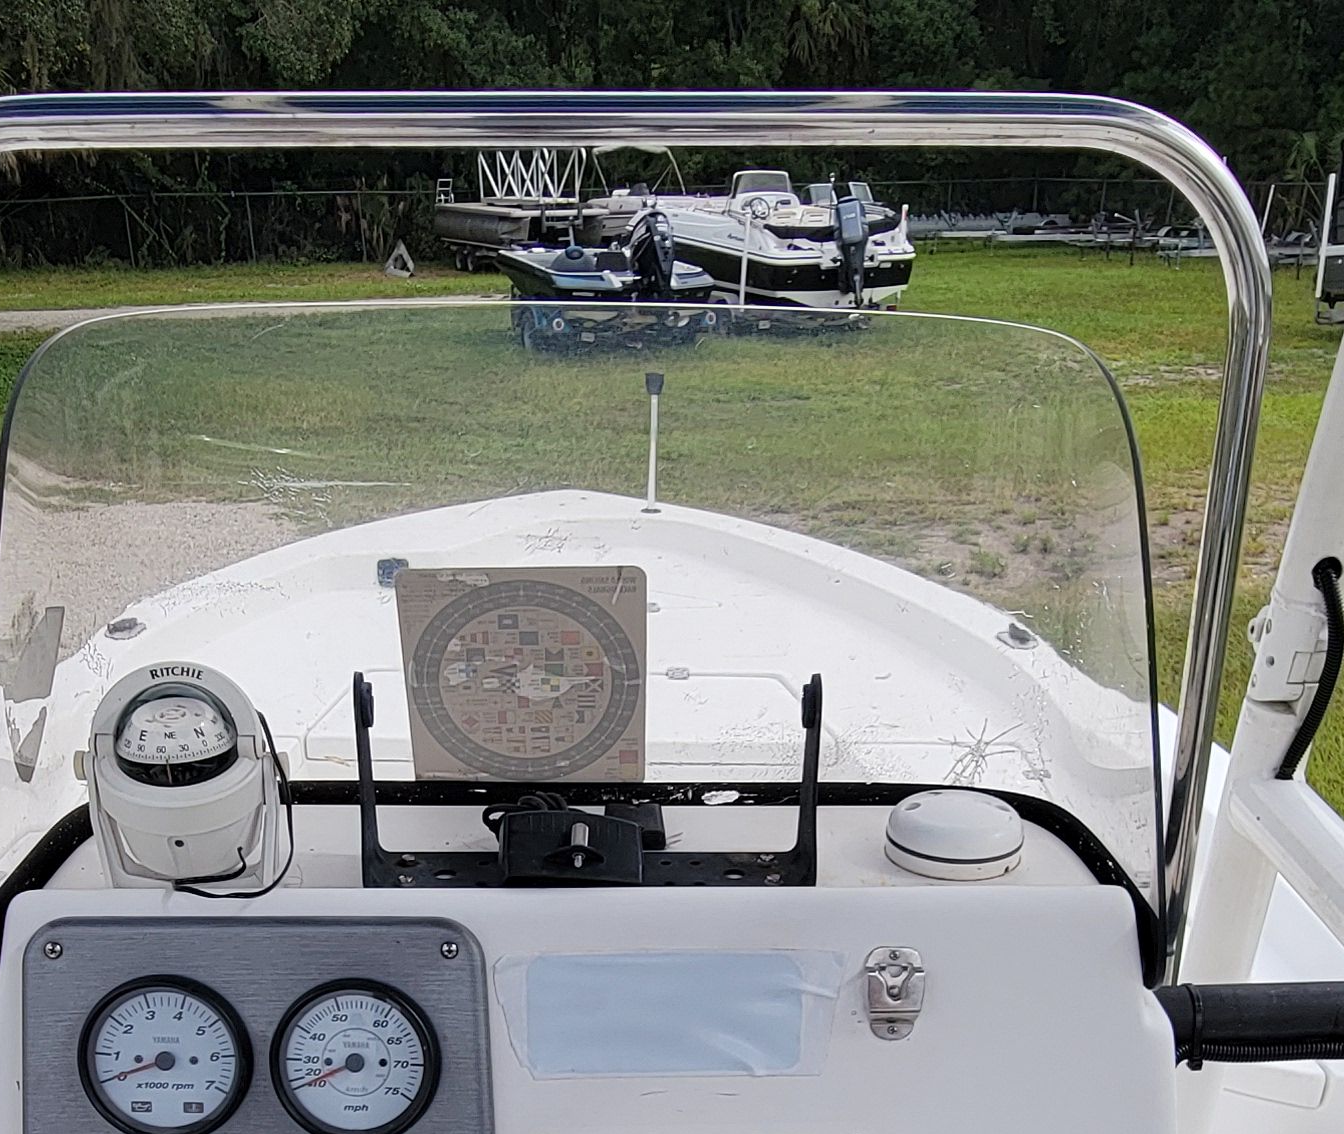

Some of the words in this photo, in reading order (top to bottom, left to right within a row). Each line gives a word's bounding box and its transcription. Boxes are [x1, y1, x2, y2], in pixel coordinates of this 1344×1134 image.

[149, 666, 204, 680] RITCHIE
[139, 729, 148, 742] E
[164, 731, 177, 740] NE
[193, 726, 206, 739] N
[156, 745, 167, 754] 60
[178, 743, 190, 752] 30
[201, 740, 208, 748] 0
[145, 1010, 156, 1021] 3
[173, 1011, 184, 1021] 4
[331, 1014, 348, 1022] 50
[372, 1019, 389, 1028] 60
[122, 1024, 134, 1035] 2
[195, 1026, 207, 1036] 5
[152, 1036, 180, 1044] YAMAHA
[309, 1033, 326, 1041] 40
[386, 1037, 403, 1045] 65
[112, 1051, 120, 1061] 1
[209, 1052, 220, 1062] 6
[303, 1055, 320, 1064] 30
[393, 1060, 409, 1069] 70
[304, 1068, 322, 1076] 20
[135, 1082, 169, 1090] x1000
[171, 1083, 194, 1091] rpm
[204, 1080, 217, 1090] 7
[384, 1087, 401, 1095] 75
[343, 1104, 369, 1112] mph
